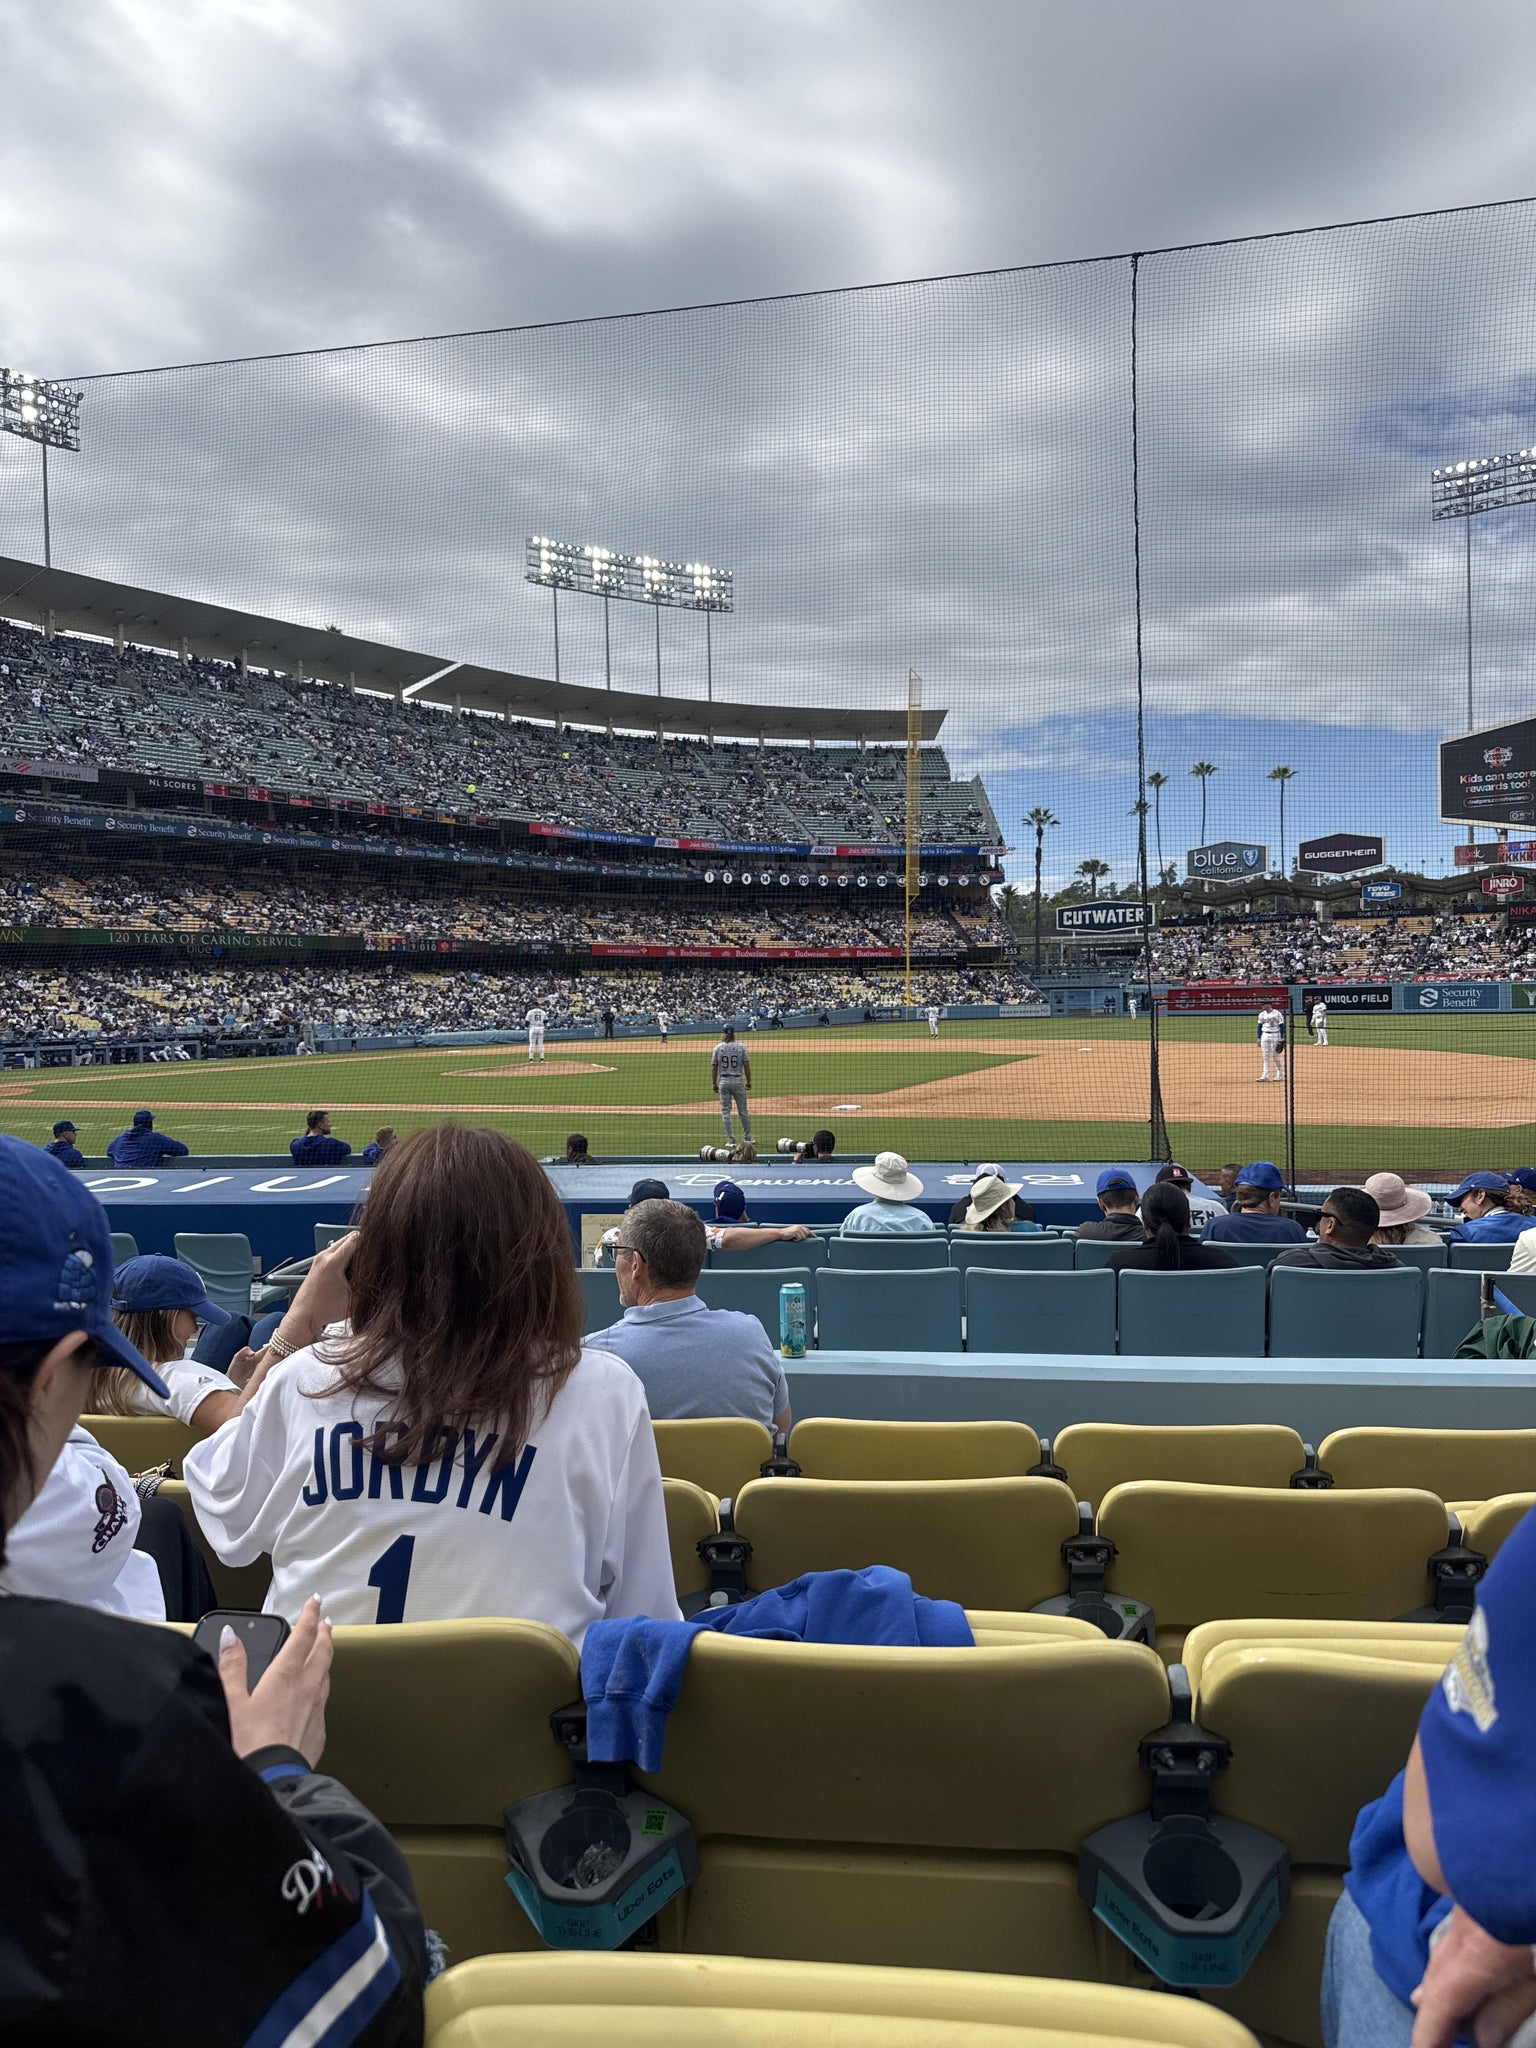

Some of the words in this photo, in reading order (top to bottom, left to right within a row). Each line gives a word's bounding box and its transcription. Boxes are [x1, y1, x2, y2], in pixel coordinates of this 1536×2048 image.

[40, 767, 60, 777] Suite
[62, 770, 81, 779] Level
[1460, 774, 1483, 784] Kids
[1485, 773, 1504, 782] can
[1506, 770, 1536, 780] score
[149, 779, 161, 787] NL
[163, 780, 197, 791] SCORES
[1465, 782, 1508, 793] rewards
[1510, 779, 1531, 789] too!
[63, 815, 92, 826] Benefit
[117, 820, 148, 833] Security
[150, 824, 175, 834] Benefit
[198, 829, 226, 841] Security
[227, 831, 251, 840] Benefit
[273, 835, 299, 846] Security
[300, 838, 322, 847] Benefit
[1194, 851, 1238, 867] blue
[1304, 848, 1377, 859] GUGGENHEIM
[1200, 866, 1243, 875] california
[761, 875, 770, 883] 14
[800, 876, 809, 885] 20
[819, 876, 828, 885] 24
[839, 876, 847, 885] 32
[858, 877, 867, 885] 34
[878, 876, 887, 885] 39
[1489, 877, 1518, 891] JINRO
[1510, 906, 1536, 915] NIKA
[1062, 908, 1145, 926] CUTWATER
[109, 932, 130, 943] 120
[134, 932, 175, 944] YEARS
[180, 933, 197, 944] OF
[201, 934, 251, 946] CARING
[256, 935, 304, 947] SERVICE
[1004, 947, 1018, 955] 3:55
[1442, 987, 1481, 998] Security
[1324, 994, 1359, 1004] UNIQLO
[1361, 994, 1389, 1003] FIELD
[1442, 998, 1477, 1007] Benefit
[721, 1055, 738, 1068] 96
[84, 1175, 368, 1192] DIU
[302, 1421, 538, 1522] JORDYN
[368, 1534, 416, 1624] 1
[617, 1894, 647, 1922] Uber
[646, 1867, 676, 1896] Eats
[1104, 1893, 1132, 1927] Uber
[1131, 1921, 1160, 1957] Eats
